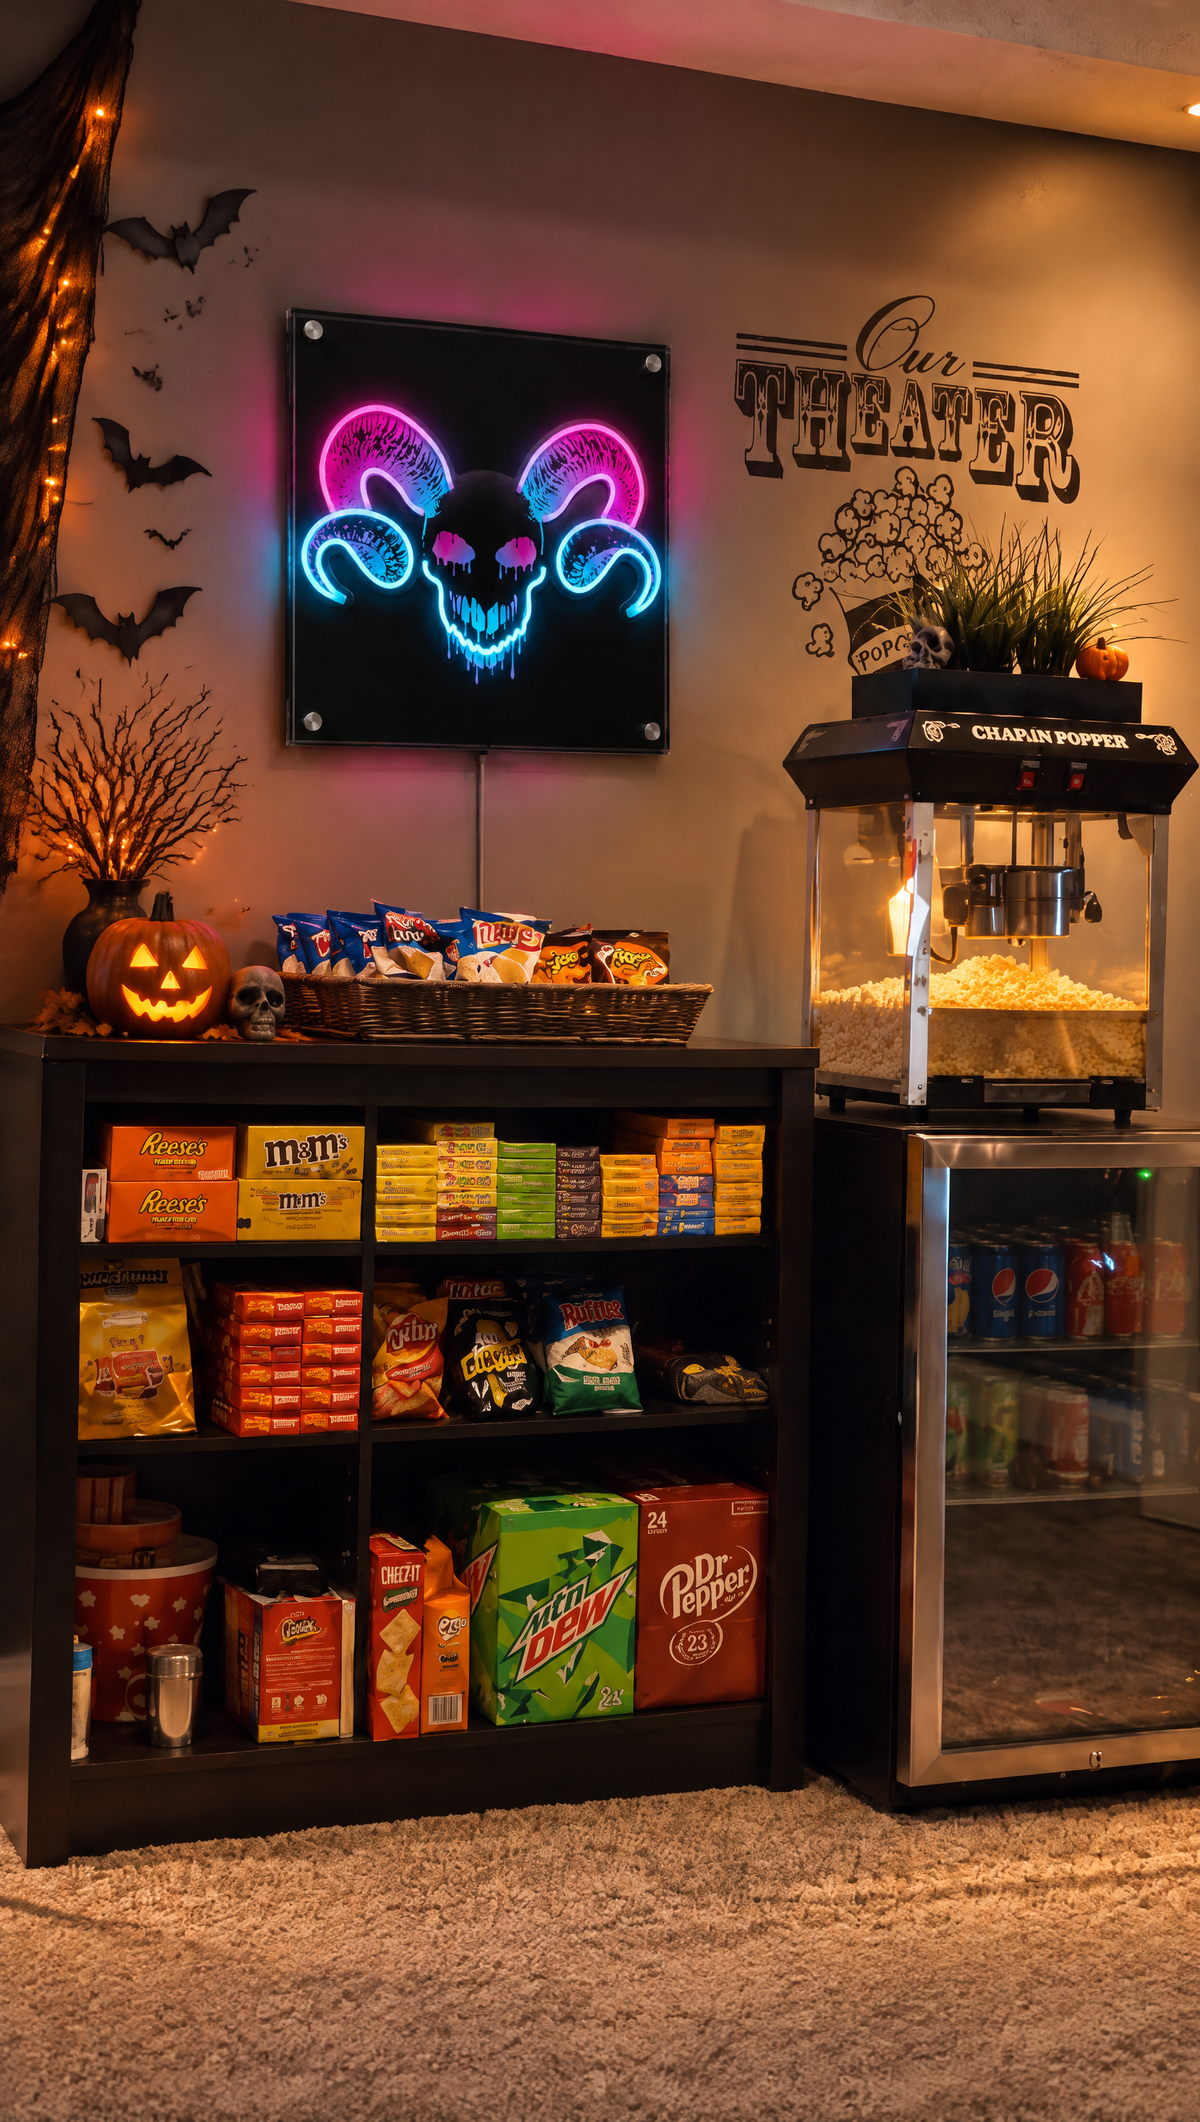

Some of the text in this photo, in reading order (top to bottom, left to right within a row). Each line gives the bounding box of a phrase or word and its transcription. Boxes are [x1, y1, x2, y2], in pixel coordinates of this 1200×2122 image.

[855, 295, 966, 377] Our
[734, 359, 1081, 504] THEATER
[858, 634, 908, 671] POPC
[1054, 730, 1129, 749] POPPER
[139, 1131, 208, 1156] Reese's
[138, 1189, 208, 1214] Reese's
[647, 1511, 668, 1528] 24
[381, 1564, 422, 1585] CHEEZ-IT
[520, 1583, 584, 1644] Mtn
[687, 1633, 708, 1652] 23
